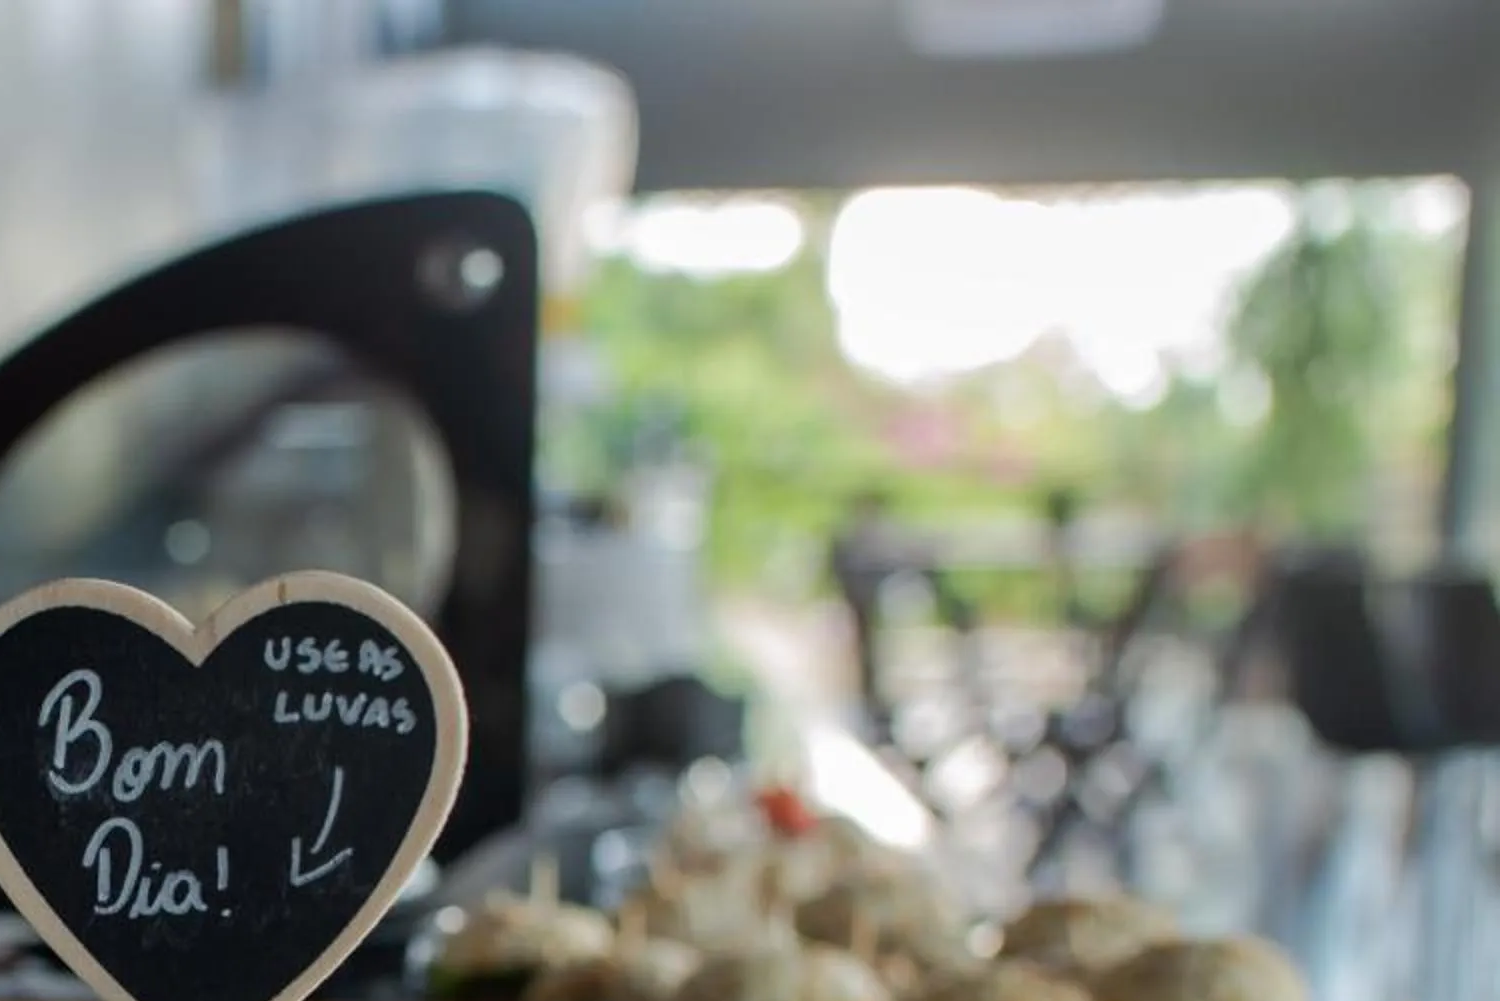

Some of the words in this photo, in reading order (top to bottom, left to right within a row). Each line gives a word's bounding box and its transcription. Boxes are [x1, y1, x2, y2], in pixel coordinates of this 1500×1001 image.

[263, 636, 349, 674] USE
[358, 640, 405, 681] AS
[38, 668, 225, 802] Bom
[273, 690, 418, 735] LUVAS
[81, 816, 233, 919] Dia!
